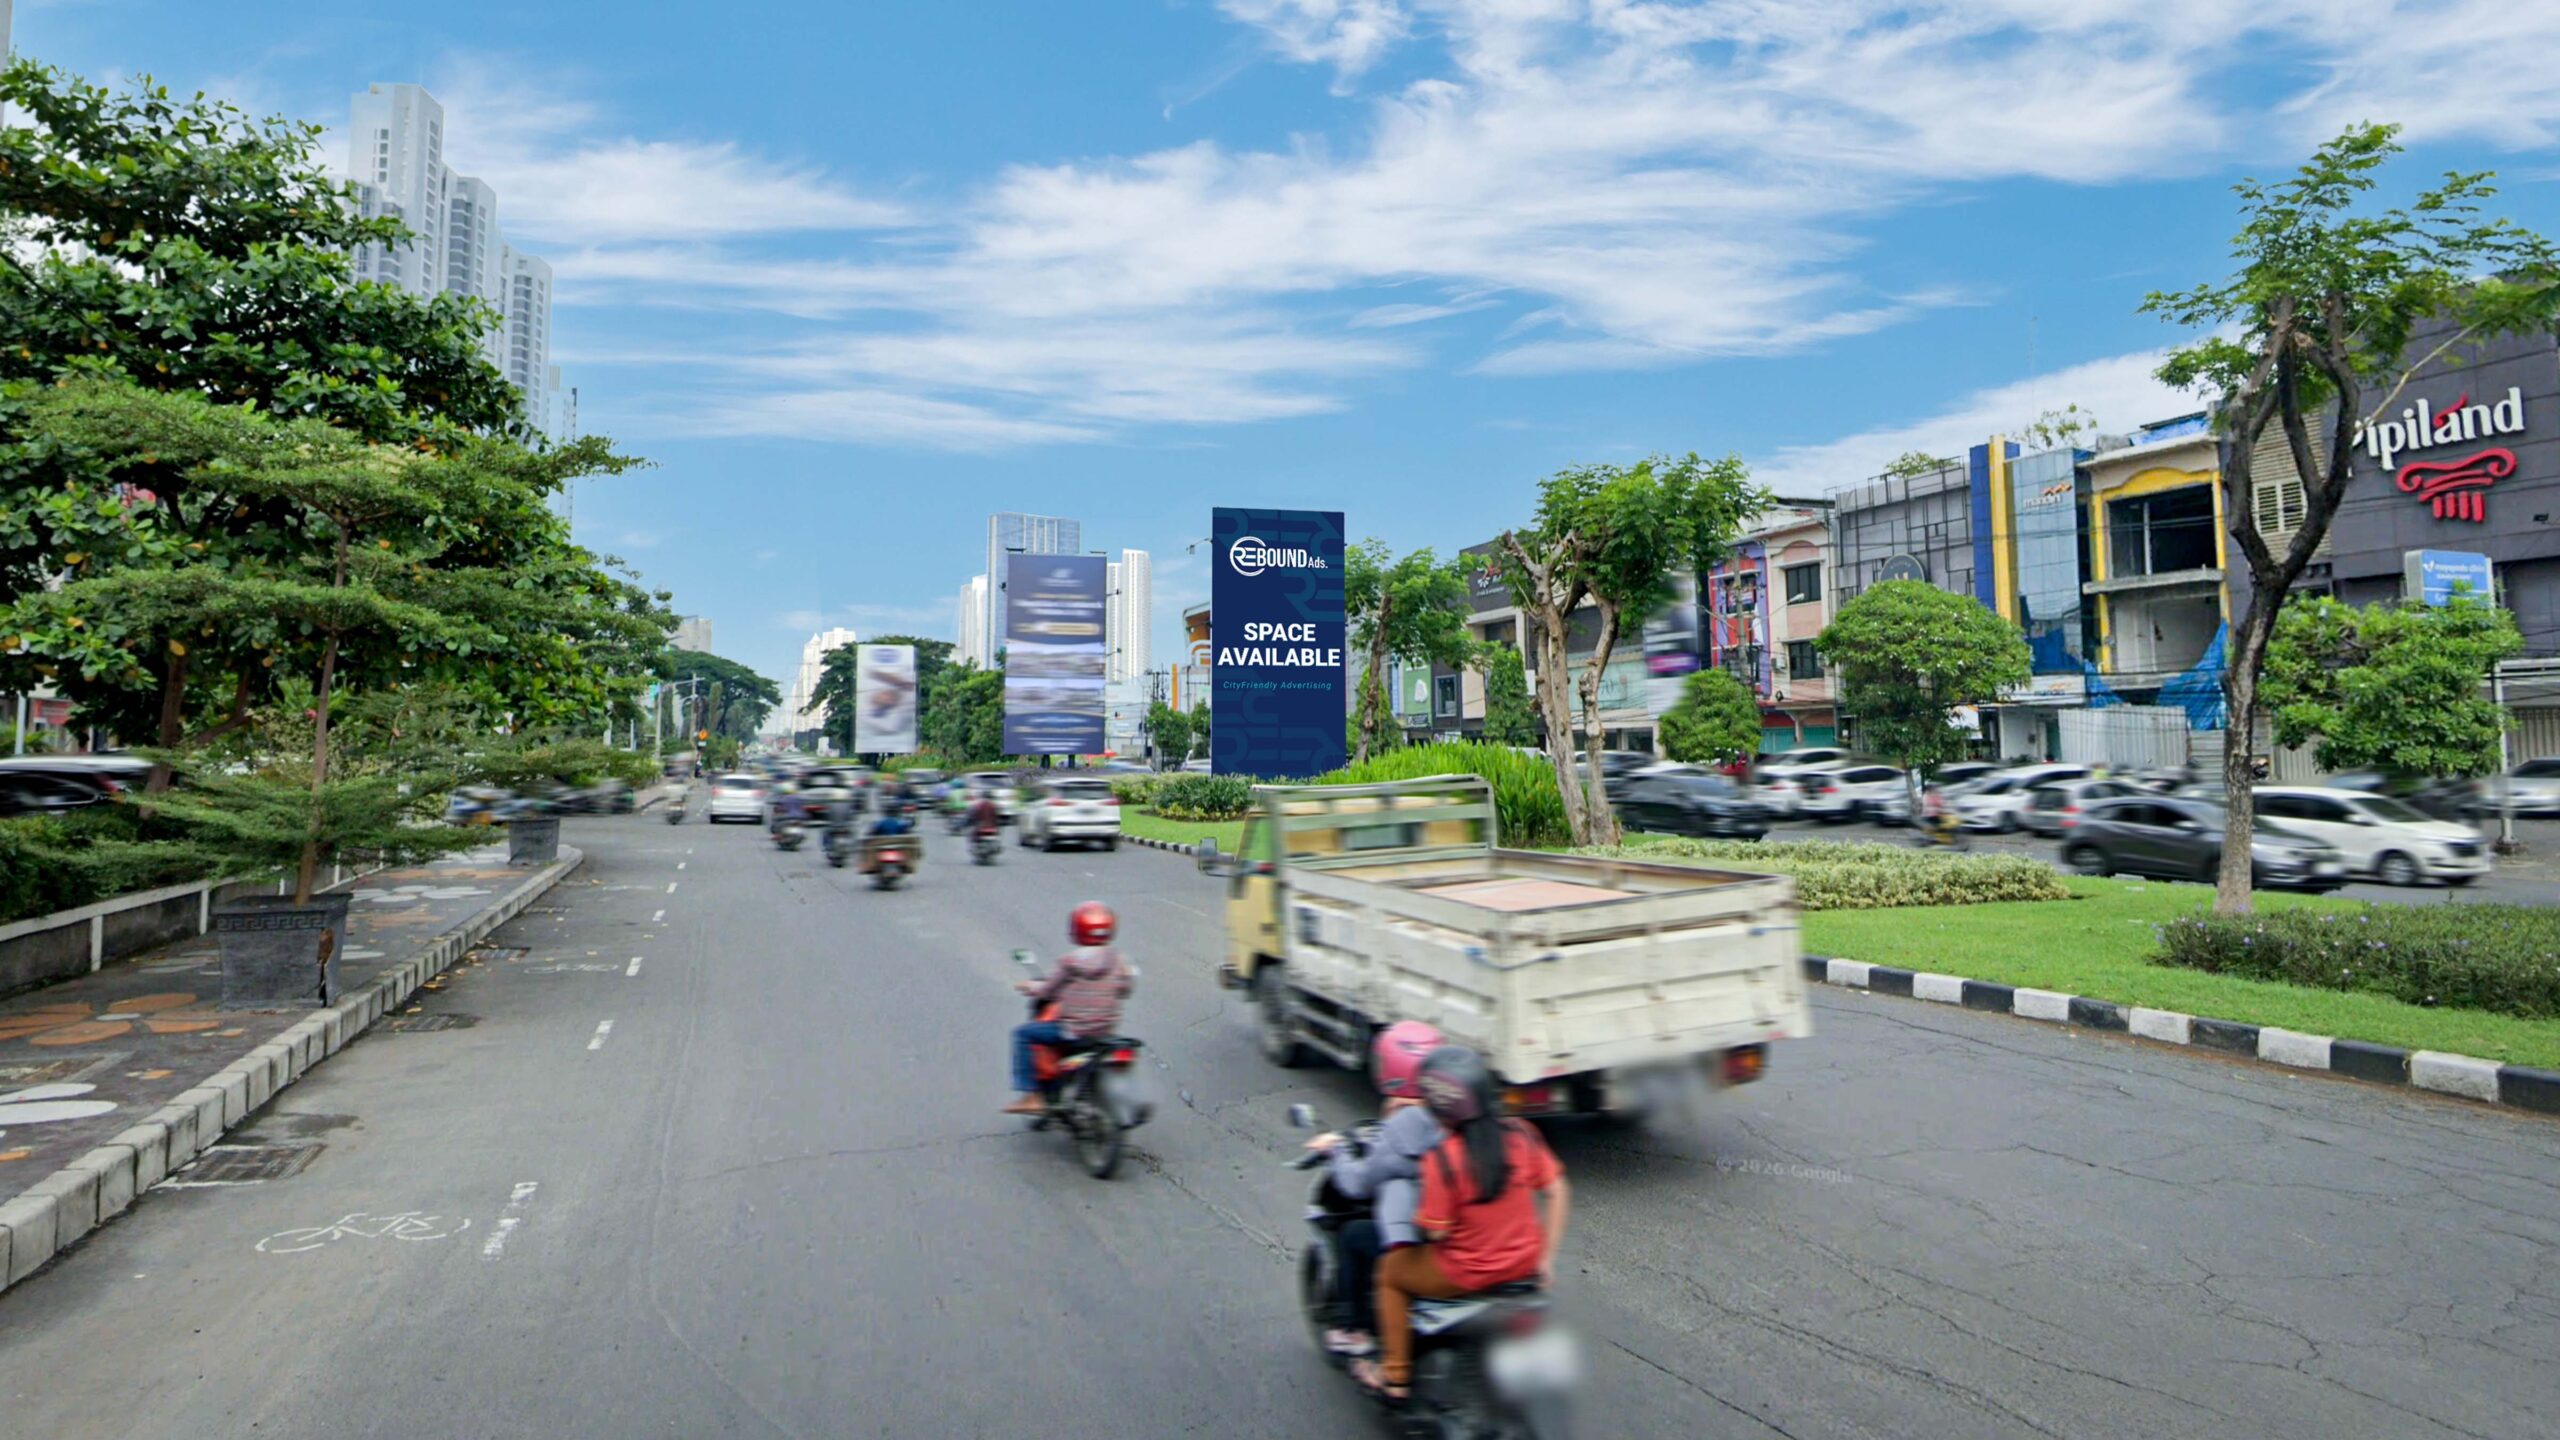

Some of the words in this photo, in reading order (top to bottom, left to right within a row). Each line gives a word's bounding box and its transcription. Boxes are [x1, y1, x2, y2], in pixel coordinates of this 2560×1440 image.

[1230, 545, 1307, 569] REBOUND
[1307, 556, 1329, 569] Ads.
[1243, 622, 1316, 642] SPACE
[1217, 647, 1341, 667] AVAILABLE
[1223, 680, 1277, 690] CityFriendly
[1280, 681, 1332, 691] Advertising
